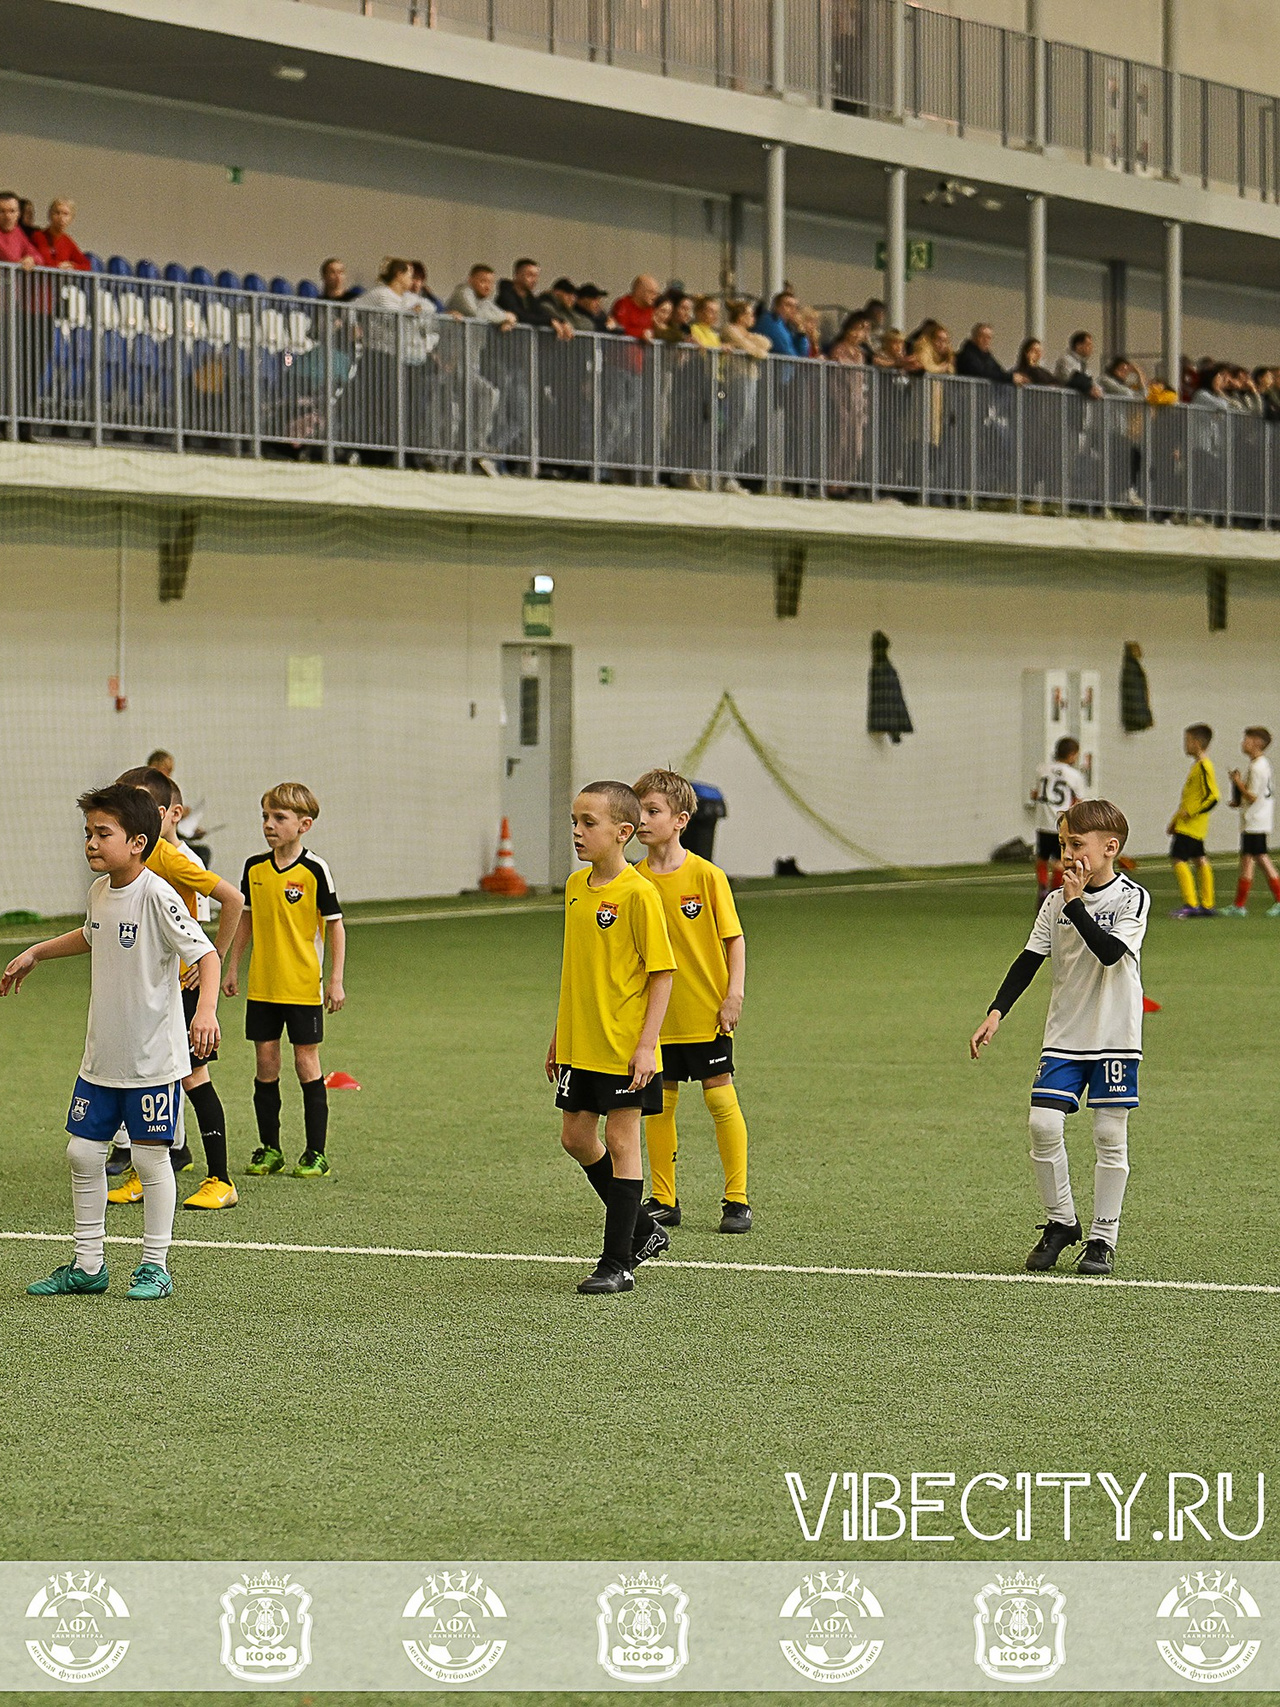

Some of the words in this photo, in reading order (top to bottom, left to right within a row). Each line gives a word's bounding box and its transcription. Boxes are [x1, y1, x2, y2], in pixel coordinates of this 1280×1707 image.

[1038, 777, 1065, 806] 15
[1103, 1060, 1123, 1084] 19
[1109, 1085, 1127, 1093] JAKO
[140, 1092, 169, 1122] 92
[147, 1124, 167, 1133] JAKO
